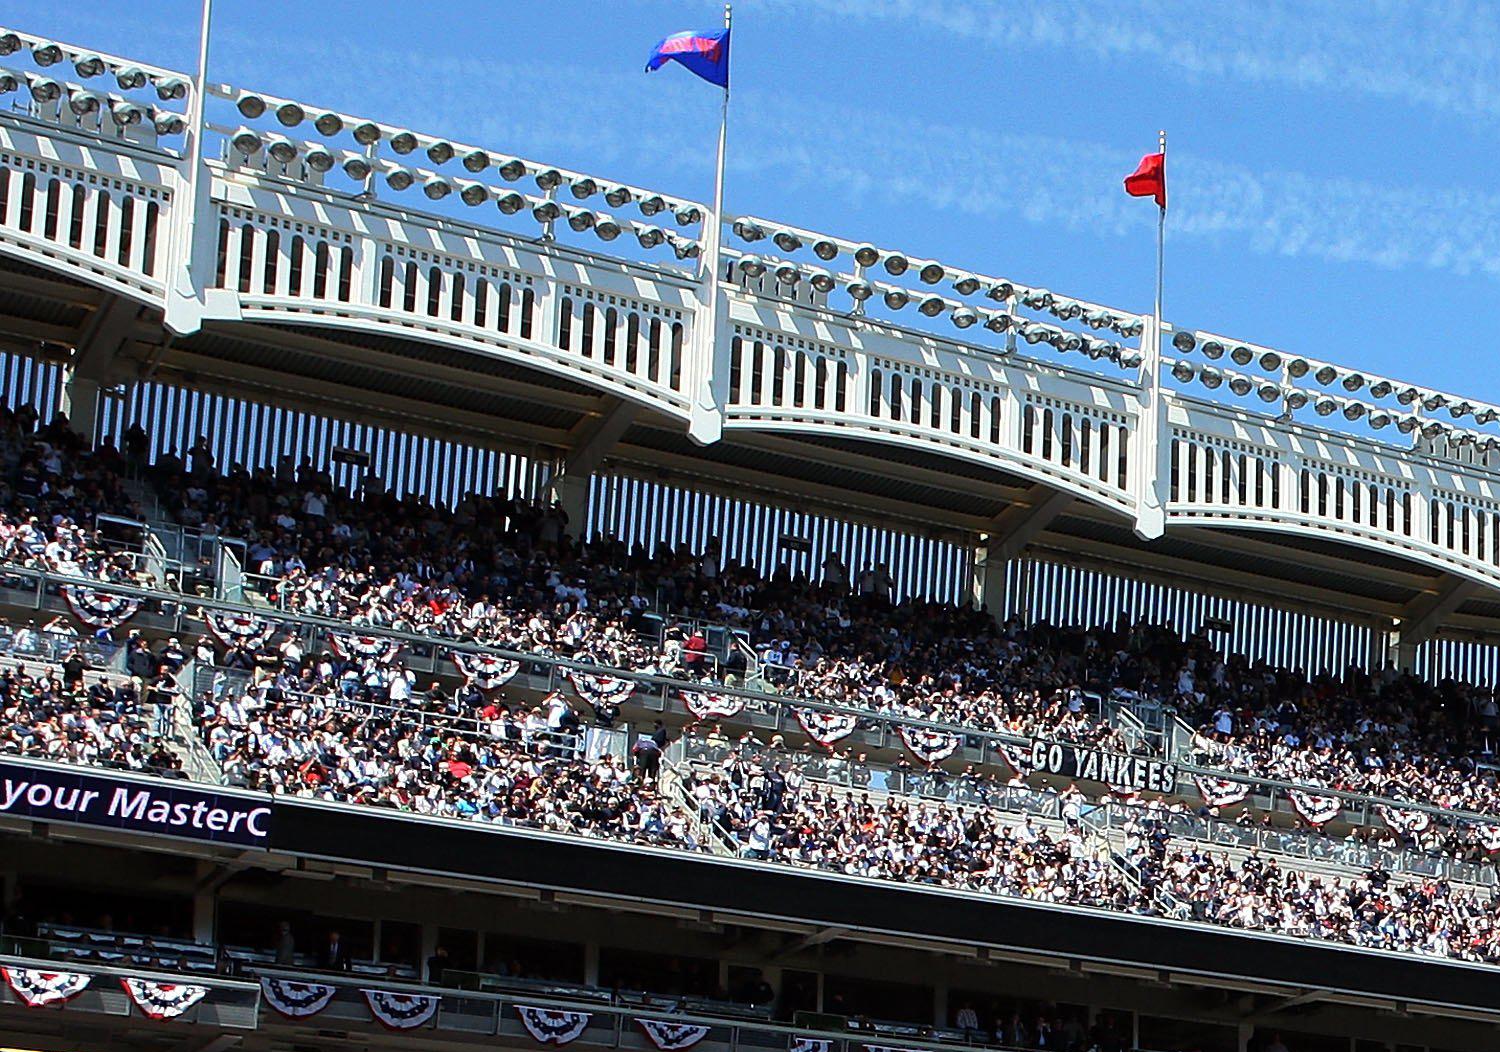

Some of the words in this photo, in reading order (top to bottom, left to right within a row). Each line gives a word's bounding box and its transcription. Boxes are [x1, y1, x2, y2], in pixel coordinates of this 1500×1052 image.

[1031, 741, 1063, 774] GO
[1074, 748, 1175, 793] YANKEES
[0, 778, 99, 812] your
[108, 787, 272, 837] MasterC
